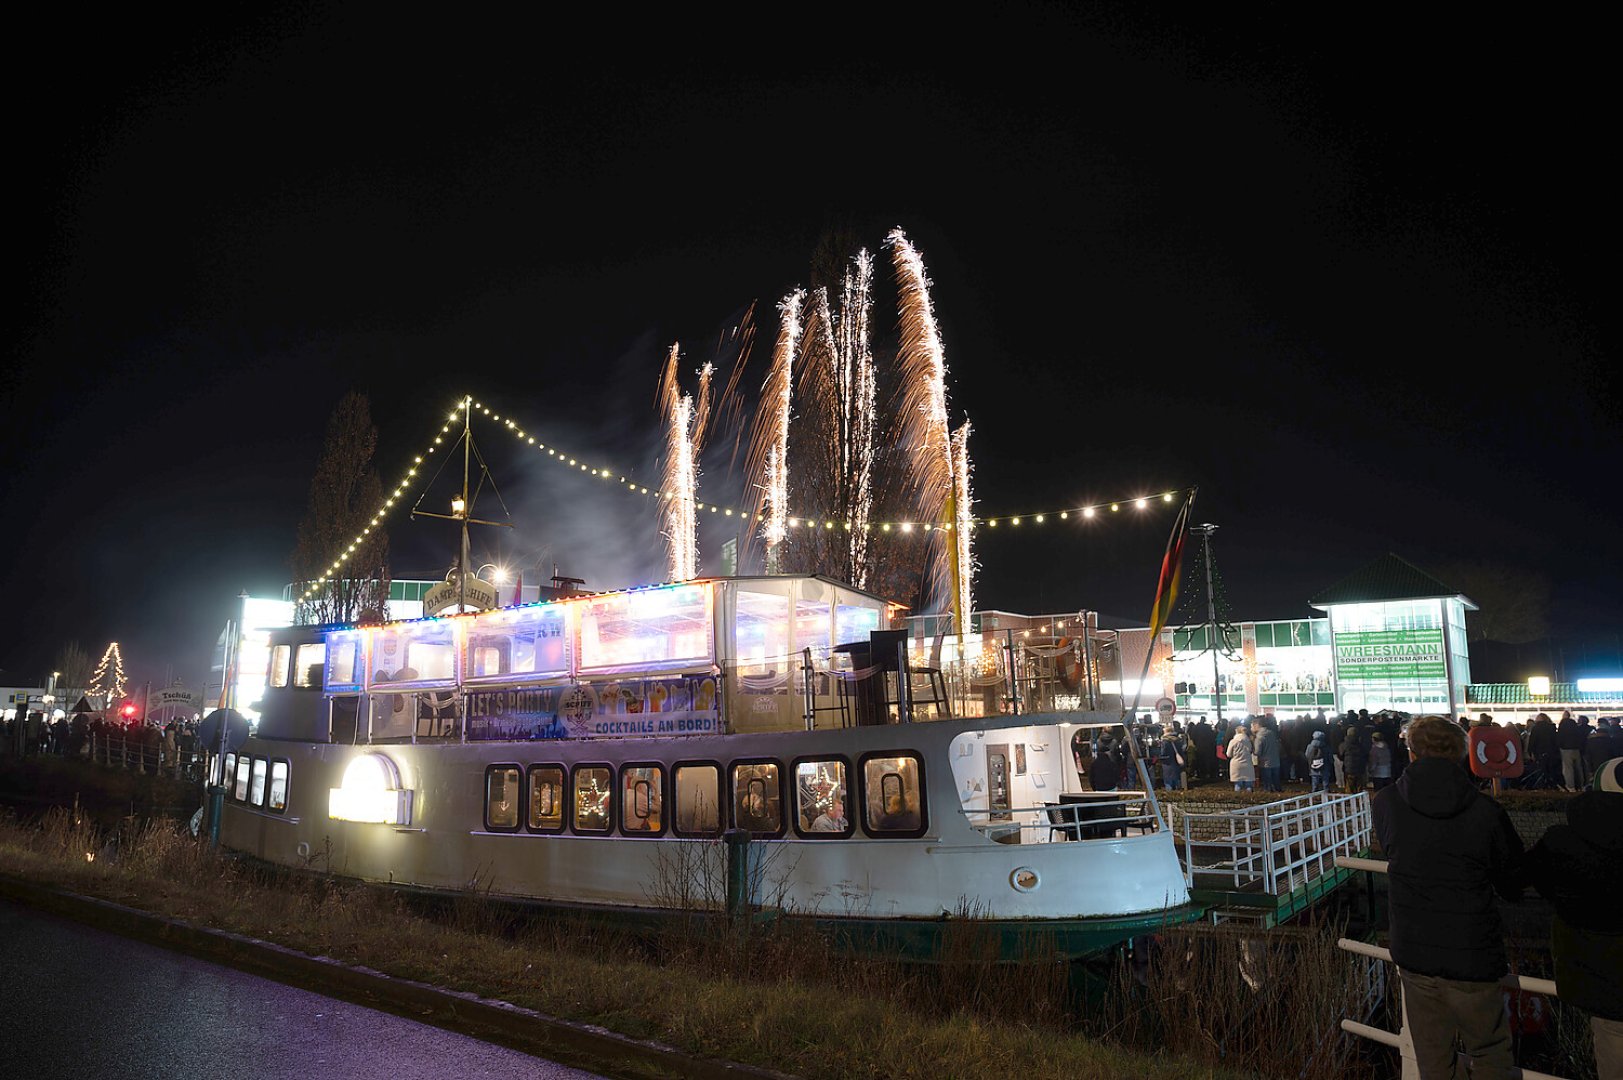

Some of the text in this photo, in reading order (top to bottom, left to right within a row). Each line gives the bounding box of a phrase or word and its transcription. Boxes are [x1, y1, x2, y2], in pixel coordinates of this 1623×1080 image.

[1340, 644, 1438, 657] WREESMANN
[471, 689, 552, 717] LET'S PARTY
[595, 718, 717, 734] COCKTAILS AN BORD!
